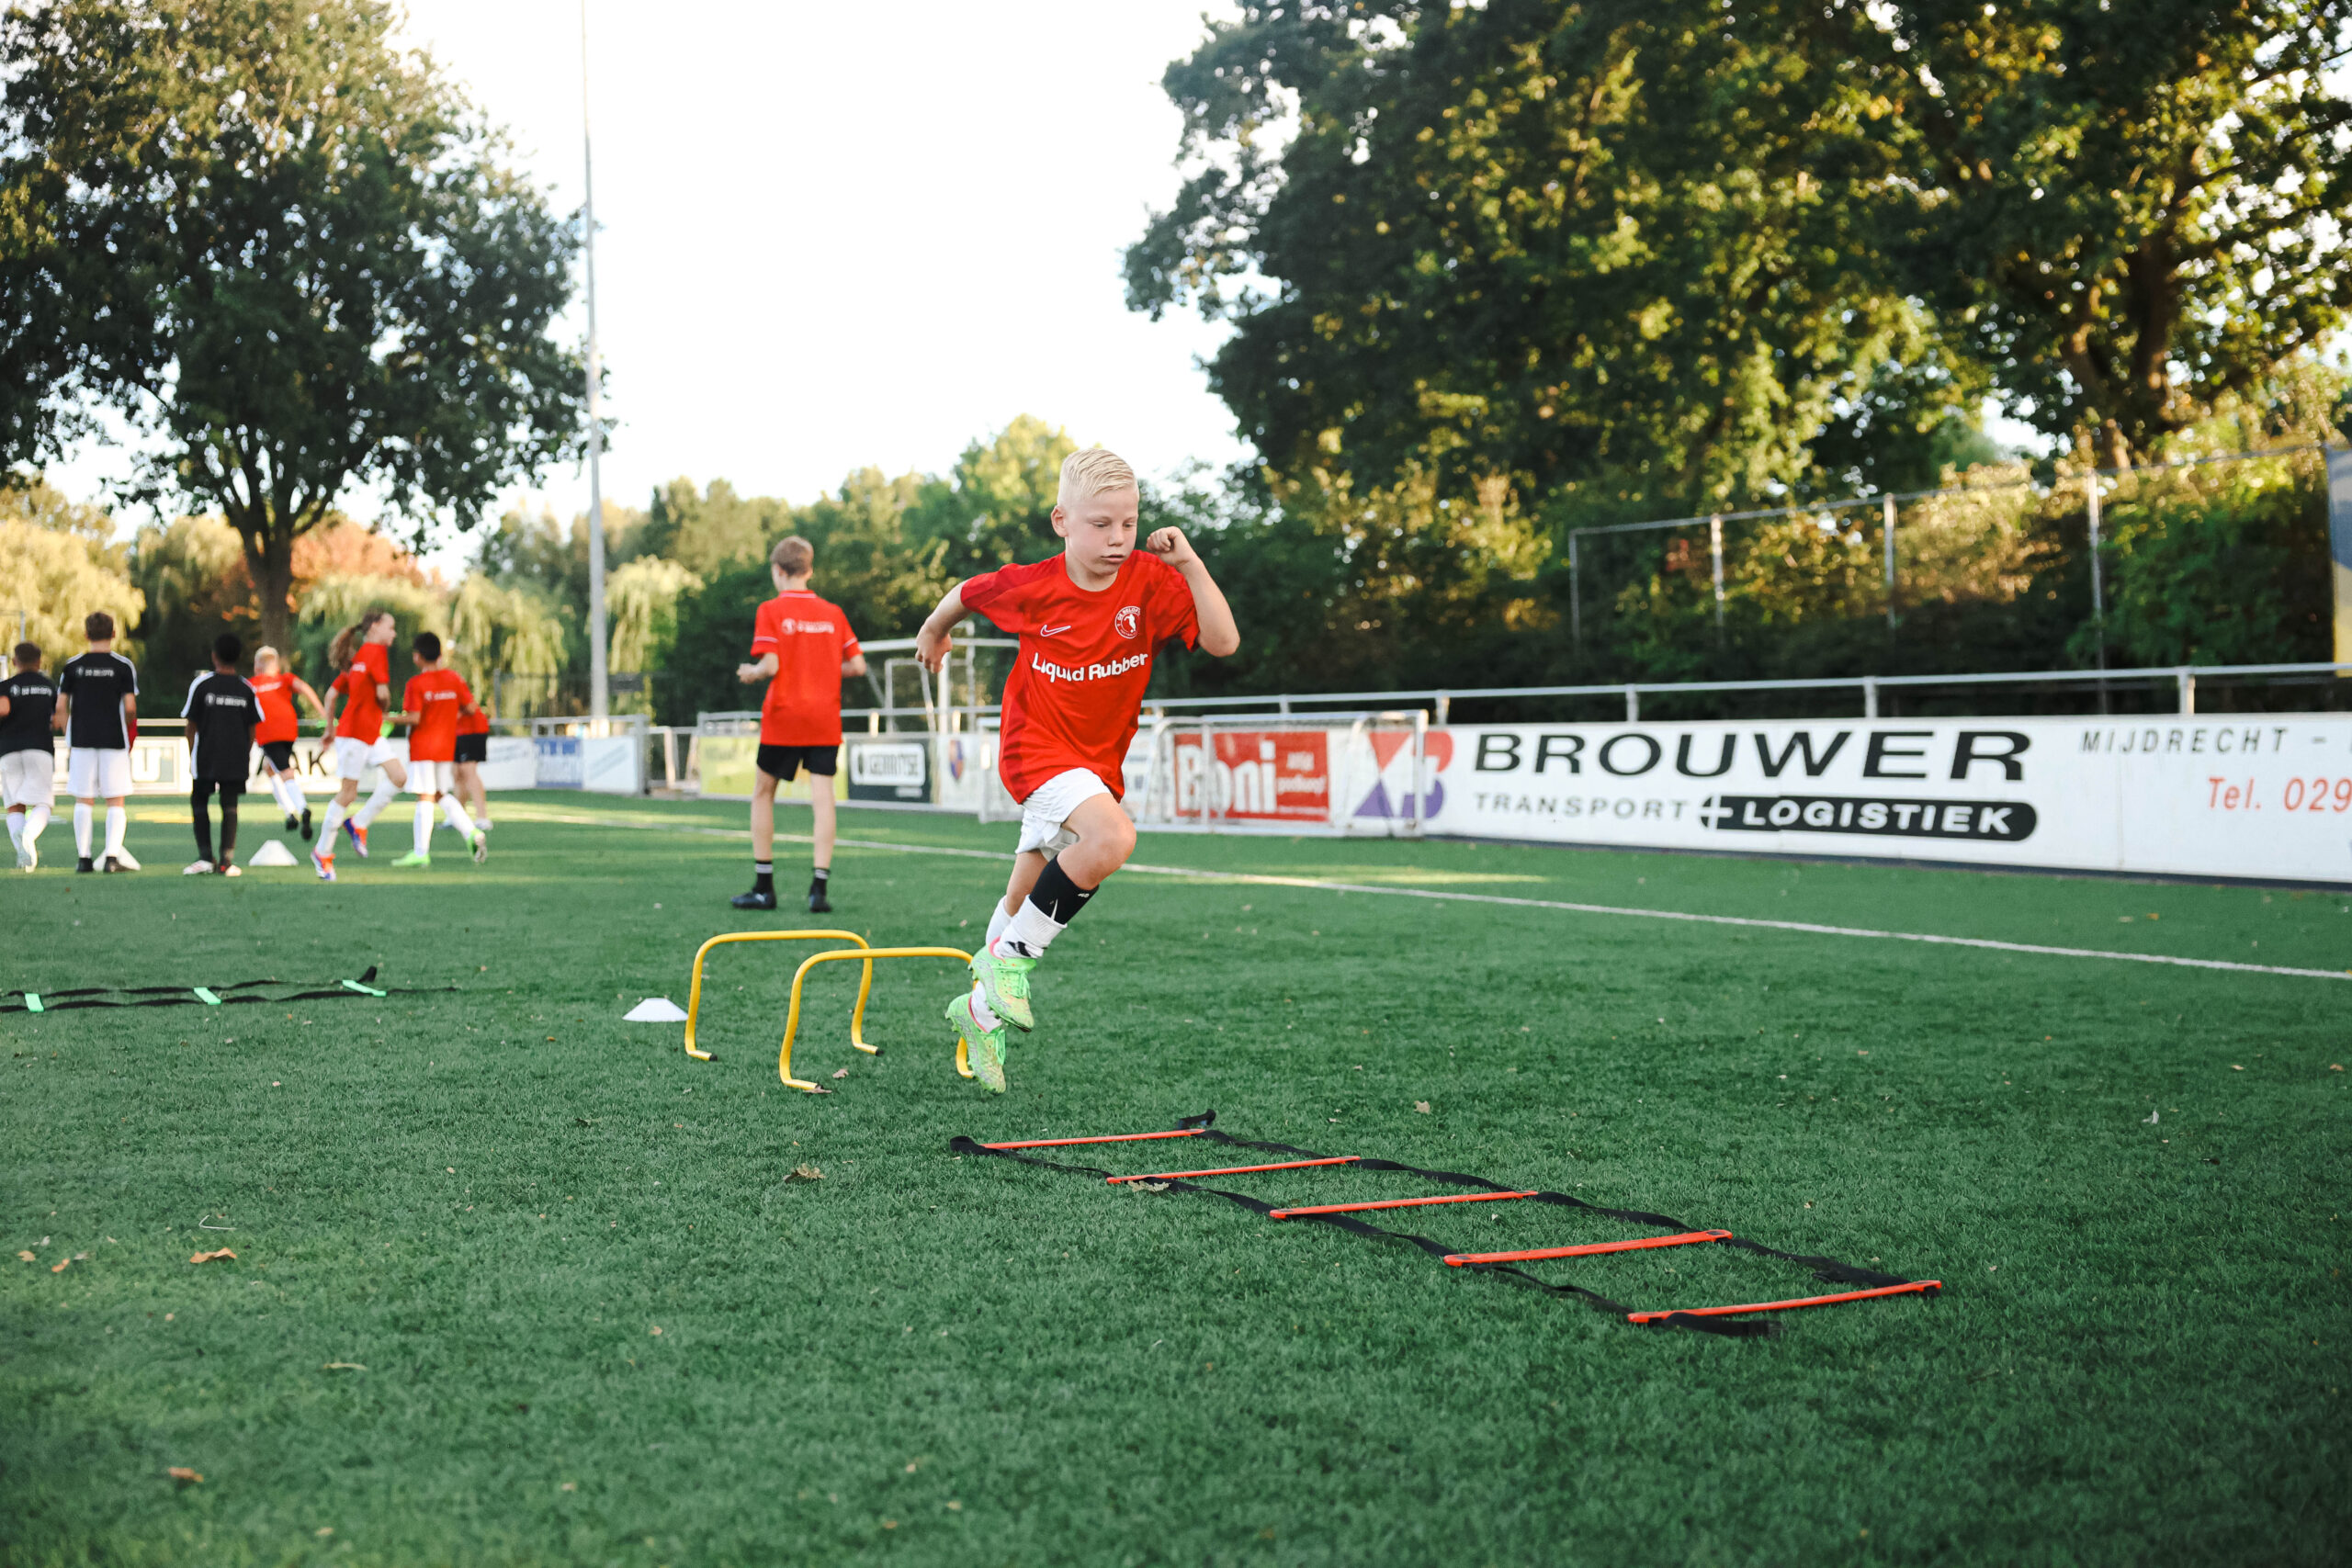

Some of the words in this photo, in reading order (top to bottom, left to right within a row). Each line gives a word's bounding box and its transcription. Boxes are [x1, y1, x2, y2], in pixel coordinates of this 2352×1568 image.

[1032, 652, 1085, 682] Liquid
[1088, 653, 1148, 681] Rubber
[1474, 730, 2032, 782] BROUWER
[2081, 727, 2289, 753] MIJDRECHT
[1473, 793, 1690, 820] TRANSPORT
[2208, 776, 2262, 810] Tel.
[2283, 776, 2352, 813] 029
[1744, 799, 2014, 835] LOGISTIEK
